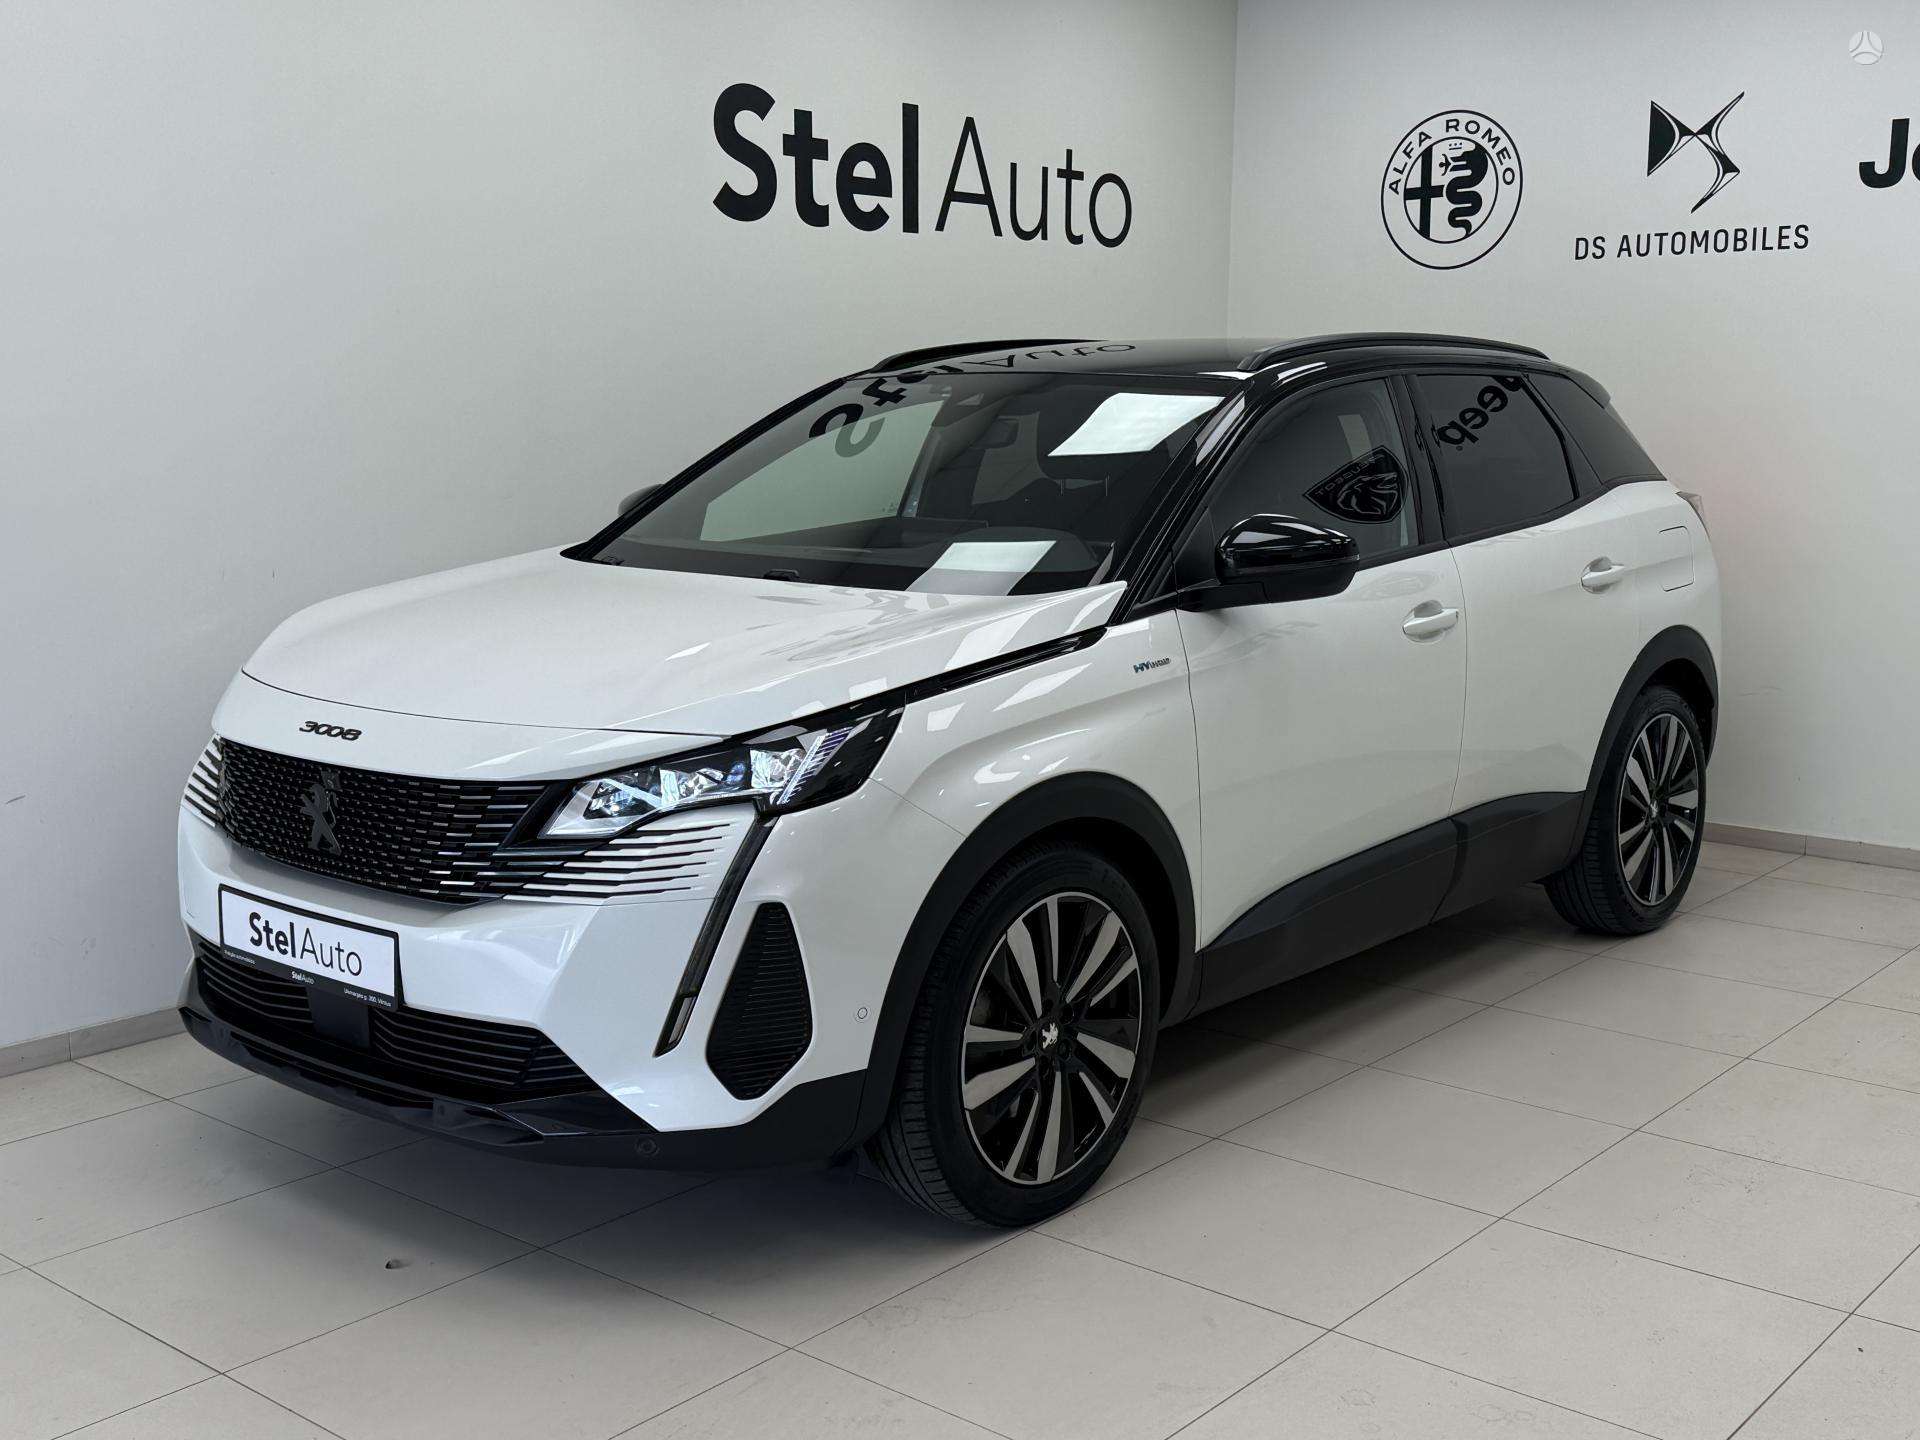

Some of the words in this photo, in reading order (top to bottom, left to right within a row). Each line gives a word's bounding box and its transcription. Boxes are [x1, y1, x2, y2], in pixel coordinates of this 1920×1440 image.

[1388, 131, 1432, 195] ALFA
[1445, 118, 1515, 186] ROMEO
[1858, 118, 1920, 188] J
[1574, 236, 1606, 260] DS
[1616, 225, 1810, 258] AUTOMOBILES
[299, 720, 362, 741] 3008
